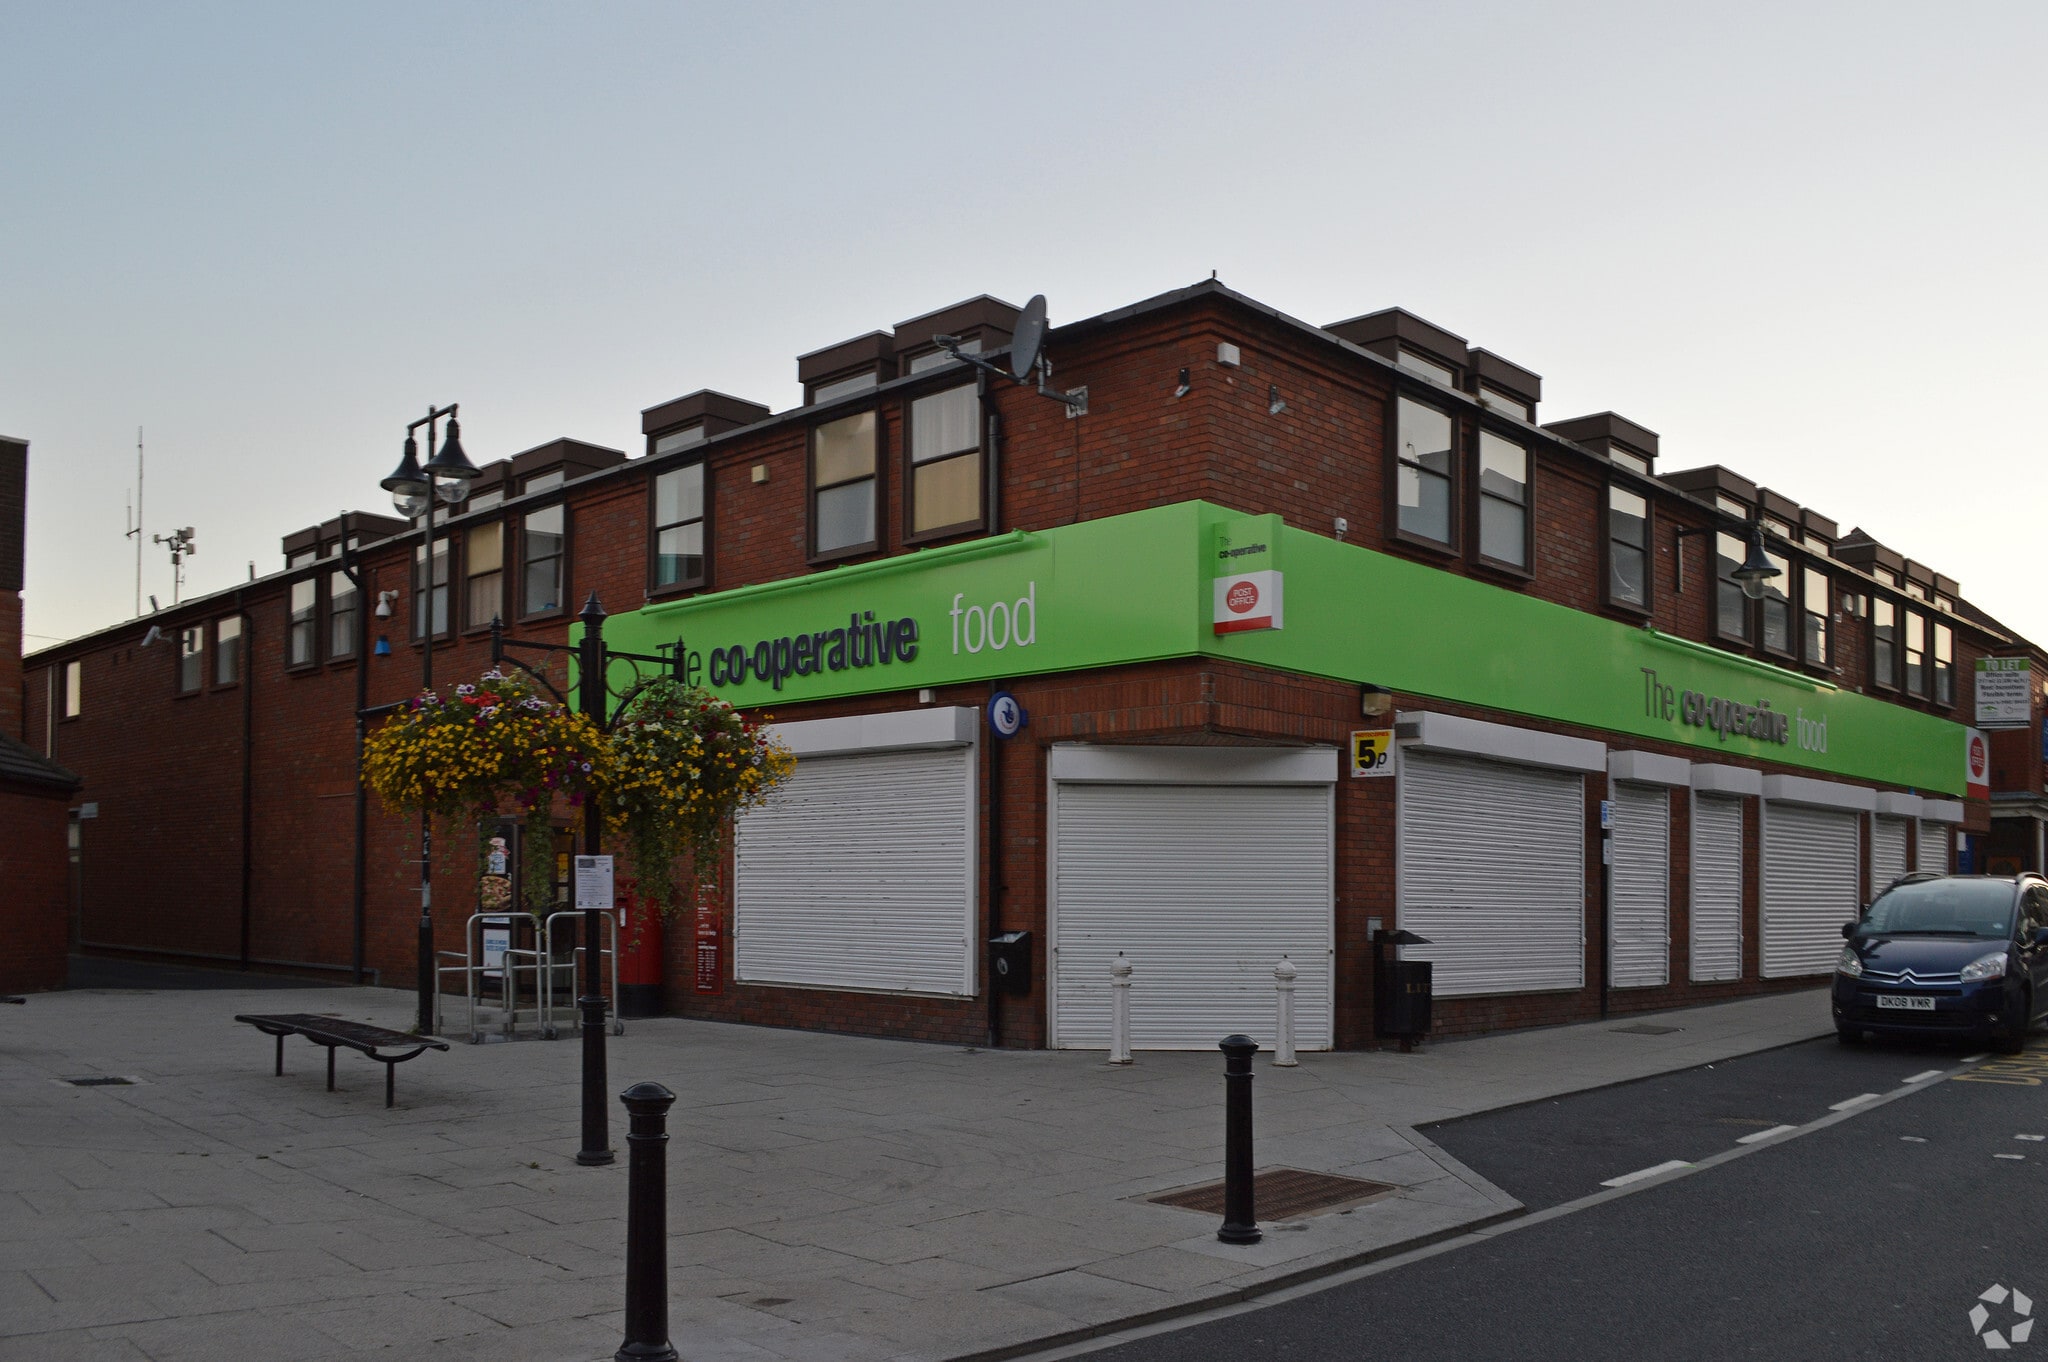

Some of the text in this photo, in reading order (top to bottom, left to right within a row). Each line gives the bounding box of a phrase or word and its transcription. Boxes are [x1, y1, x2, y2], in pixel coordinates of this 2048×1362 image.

[1219, 536, 1232, 548] The
[1219, 543, 1267, 559] co-operative
[1233, 587, 1253, 598] POST
[1229, 596, 1255, 607] OFFICE
[709, 610, 918, 690] co-operative
[949, 581, 1037, 655] food
[1985, 660, 2021, 671] TO LET
[1641, 667, 1827, 754] The co-operative food
[1358, 739, 1388, 769] 5p
